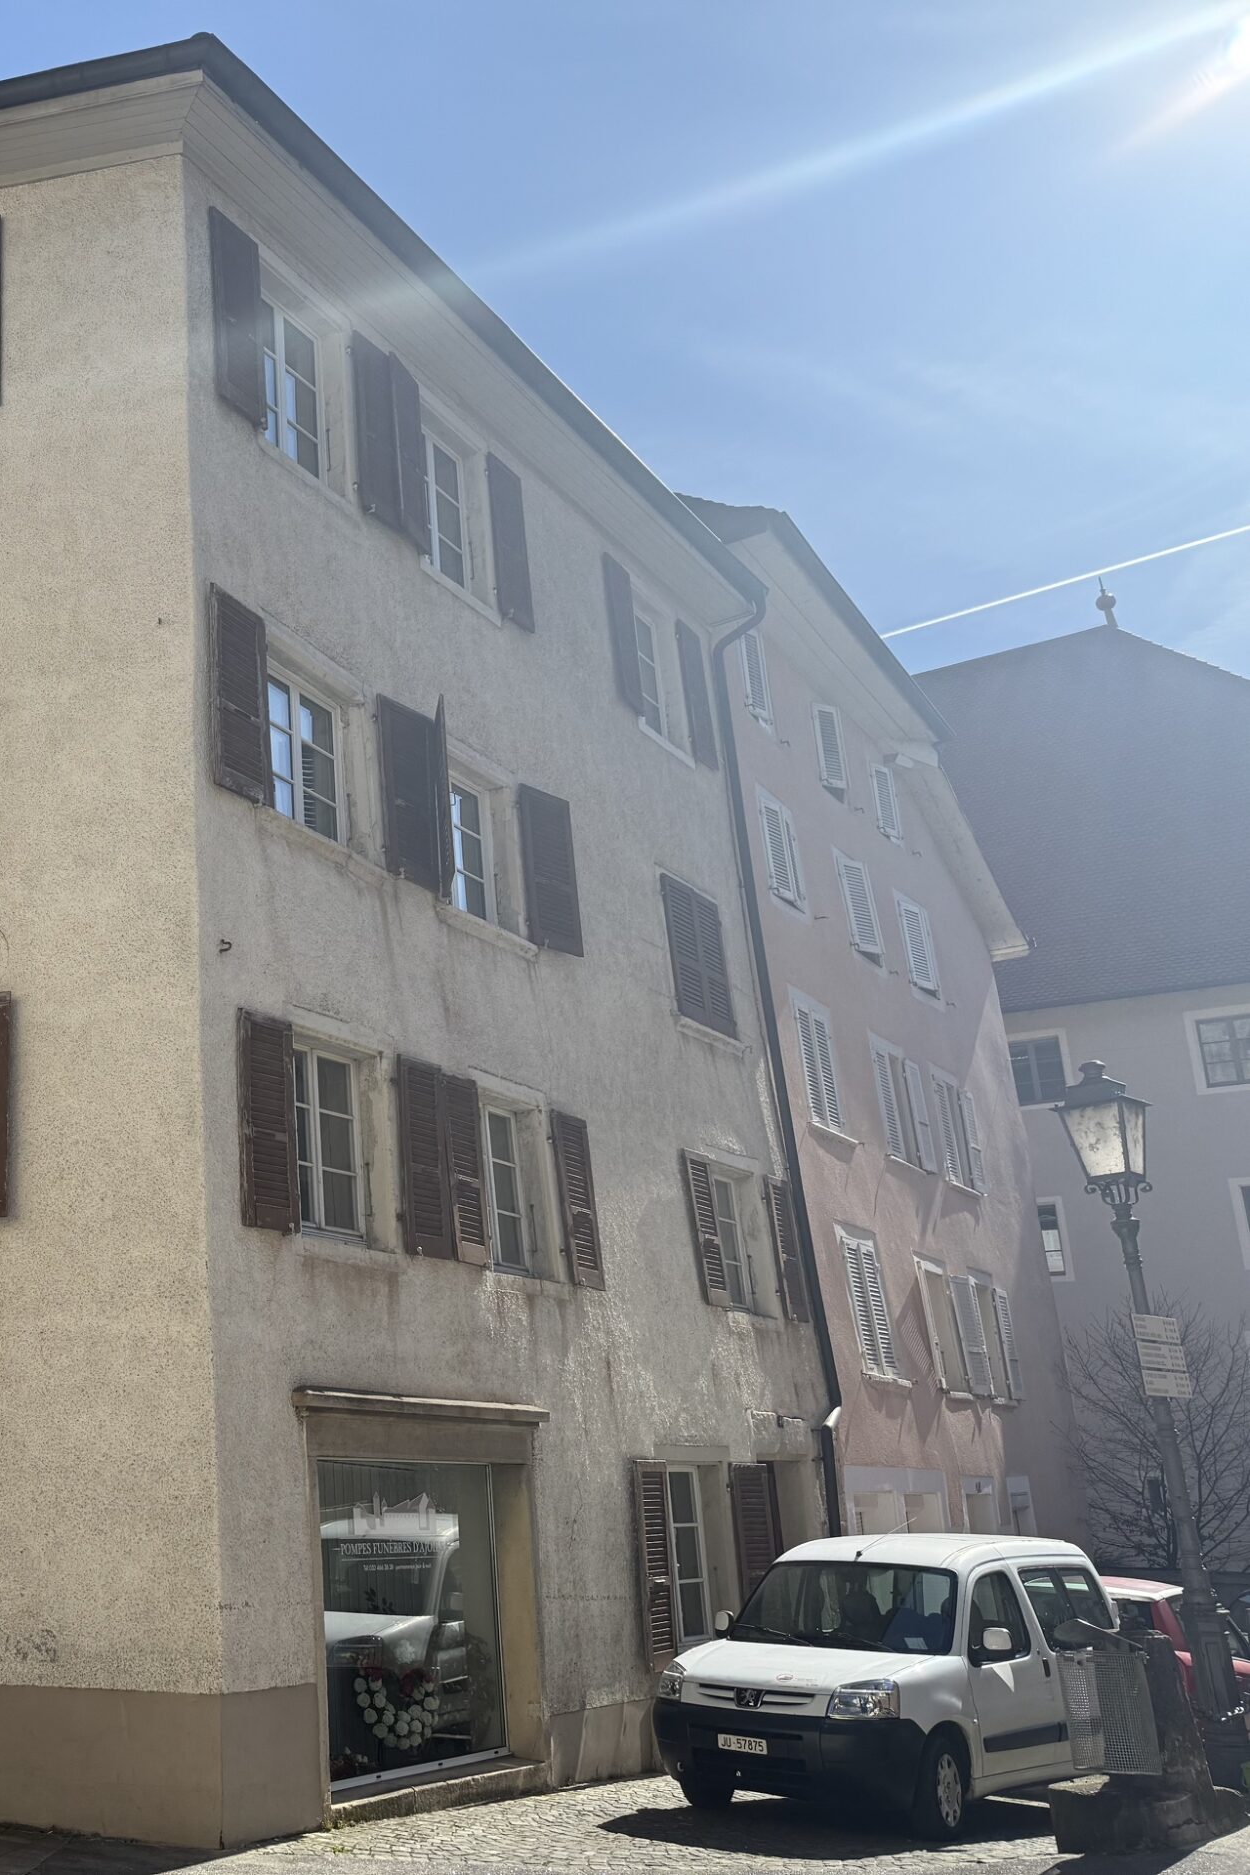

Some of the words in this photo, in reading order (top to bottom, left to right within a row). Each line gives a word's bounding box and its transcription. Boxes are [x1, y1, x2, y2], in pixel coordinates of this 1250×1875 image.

[340, 1542, 371, 1555] POMPES
[721, 1736, 731, 1748] JU
[736, 1738, 764, 1752] 57875
